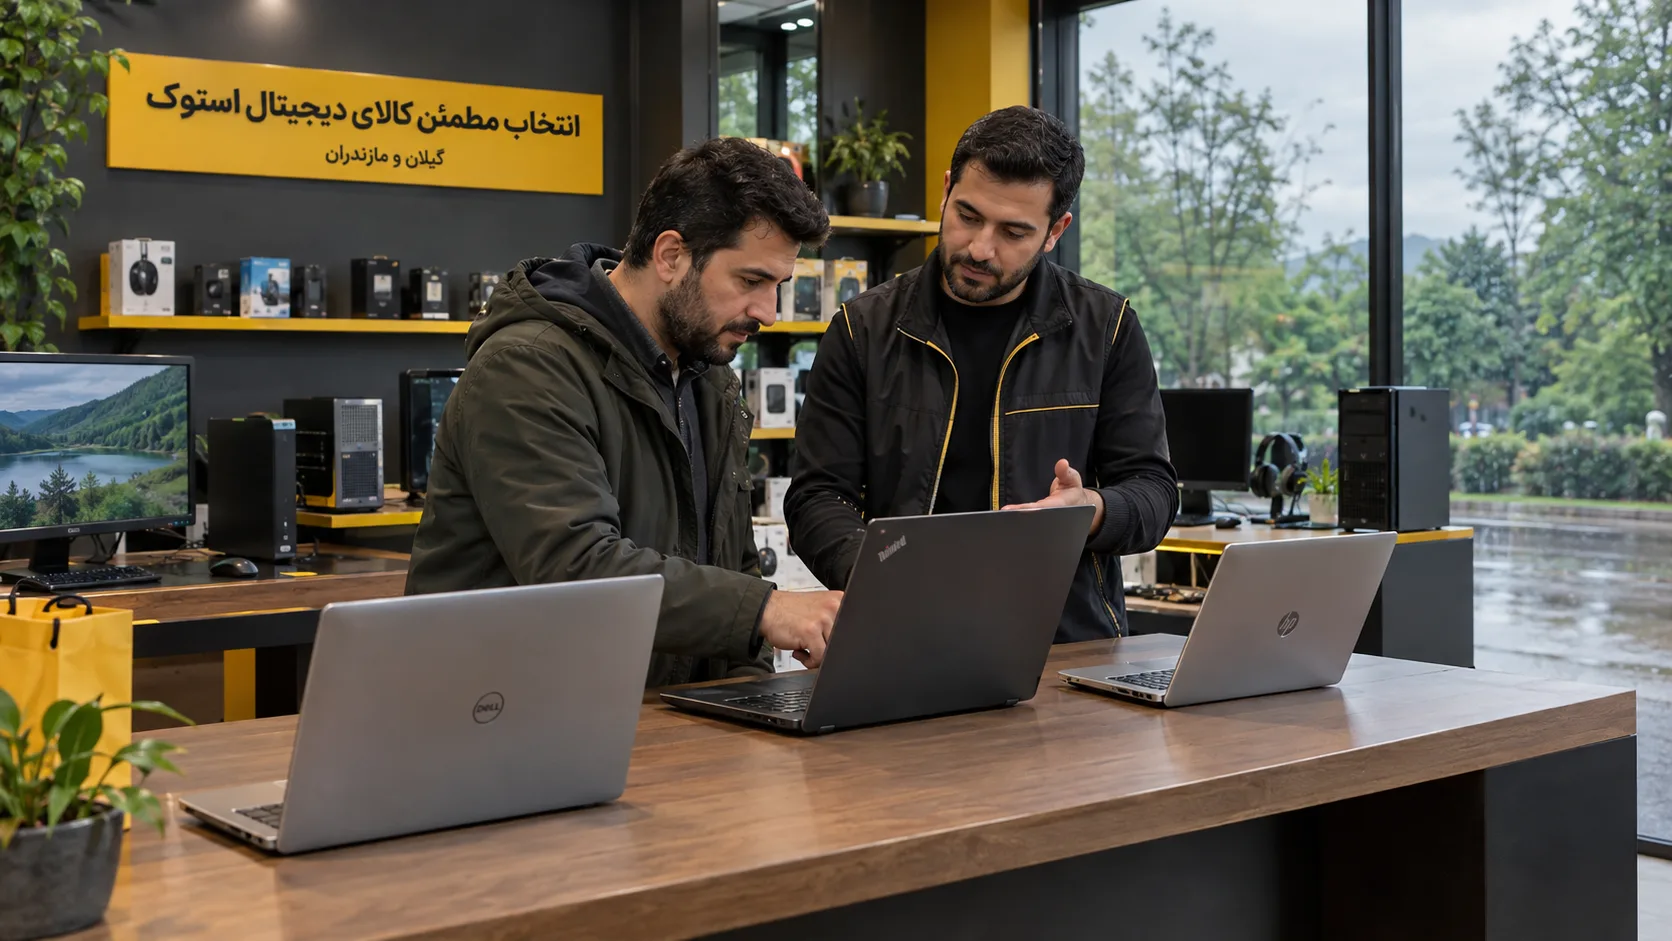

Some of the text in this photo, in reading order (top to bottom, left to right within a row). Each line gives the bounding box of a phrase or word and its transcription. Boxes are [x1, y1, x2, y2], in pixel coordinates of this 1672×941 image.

[146, 82, 581, 140] انتخاب مطمئن کالای دیجیتال استوک
[325, 144, 445, 169] گیلان و مازندران
[1278, 611, 1298, 637] hp
